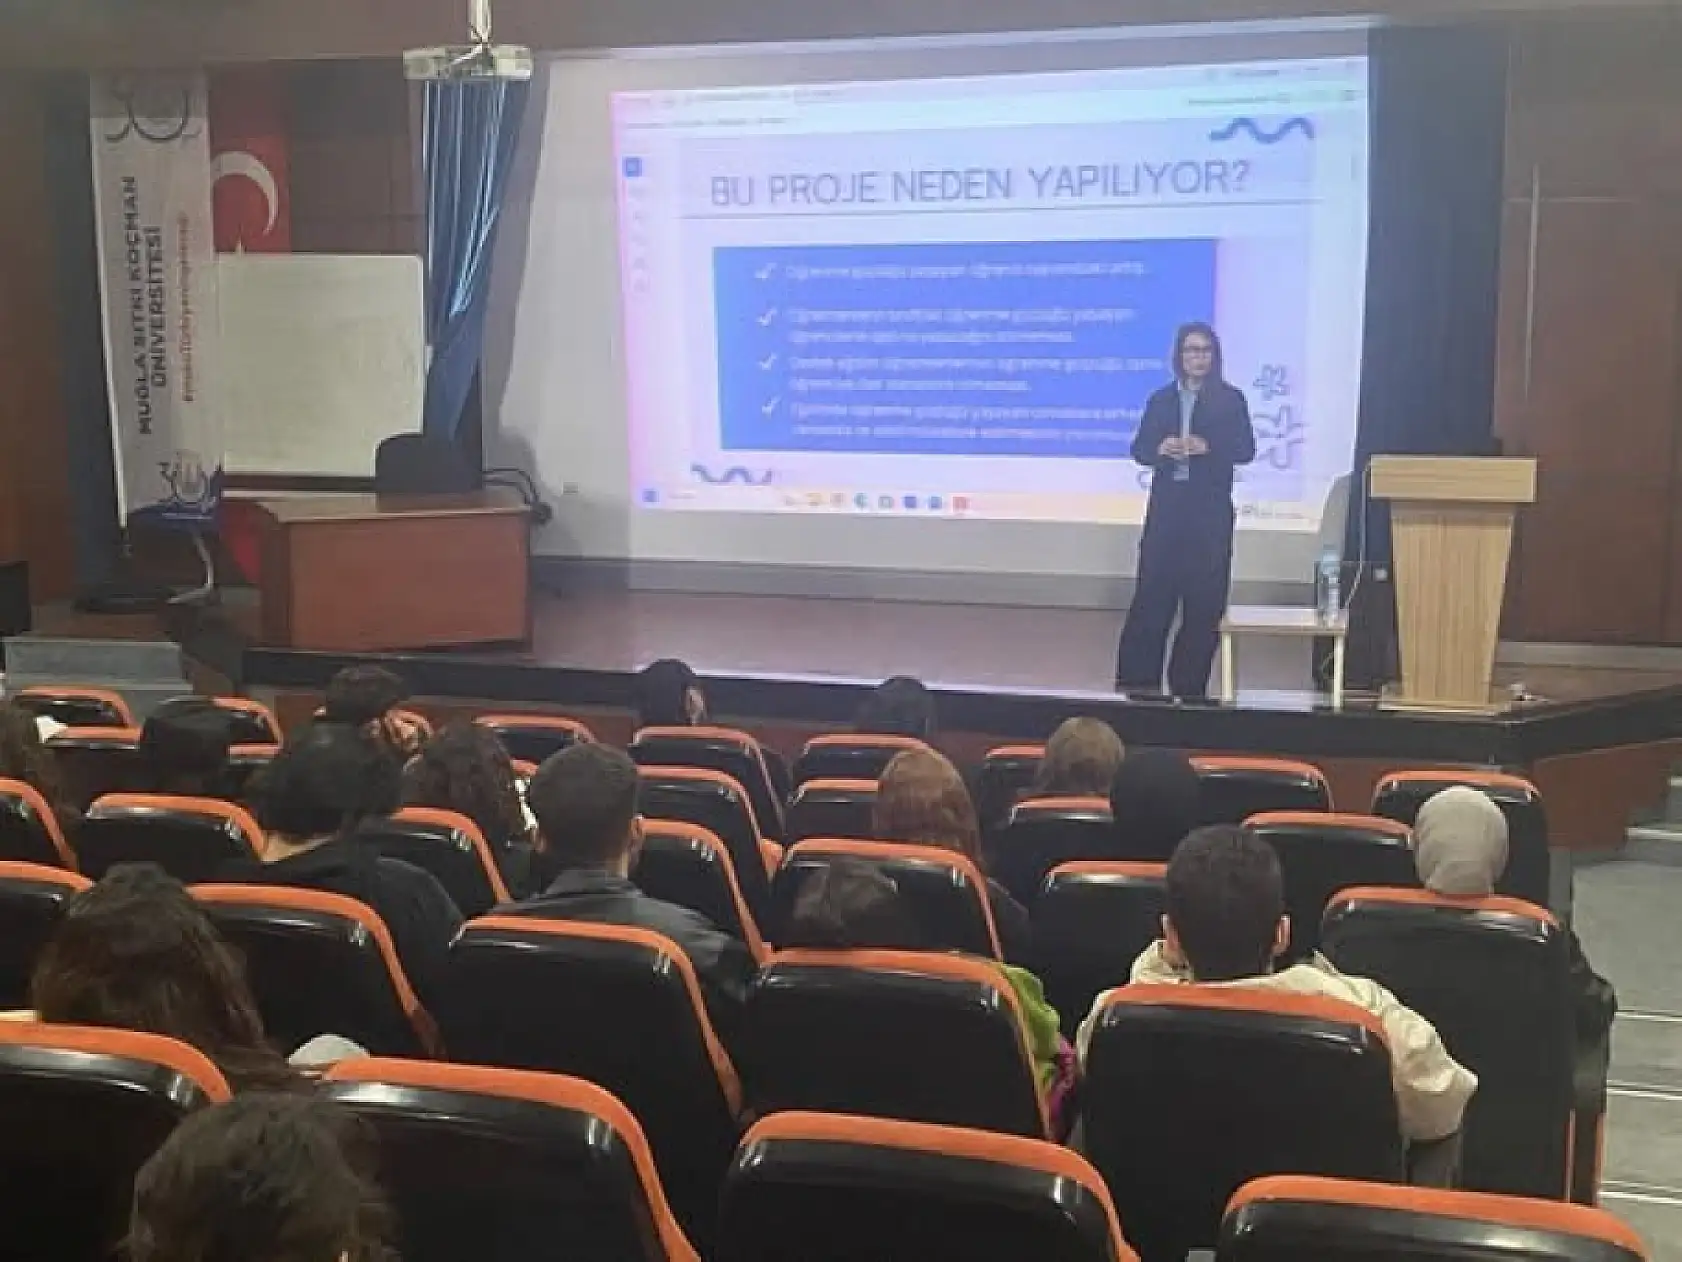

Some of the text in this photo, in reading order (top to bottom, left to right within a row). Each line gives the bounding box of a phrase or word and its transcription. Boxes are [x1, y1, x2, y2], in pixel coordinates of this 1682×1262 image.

[711, 157, 1251, 206] BU PROJE NEDEN YAPILIYOR?
[121, 176, 143, 281] KOÇMAN
